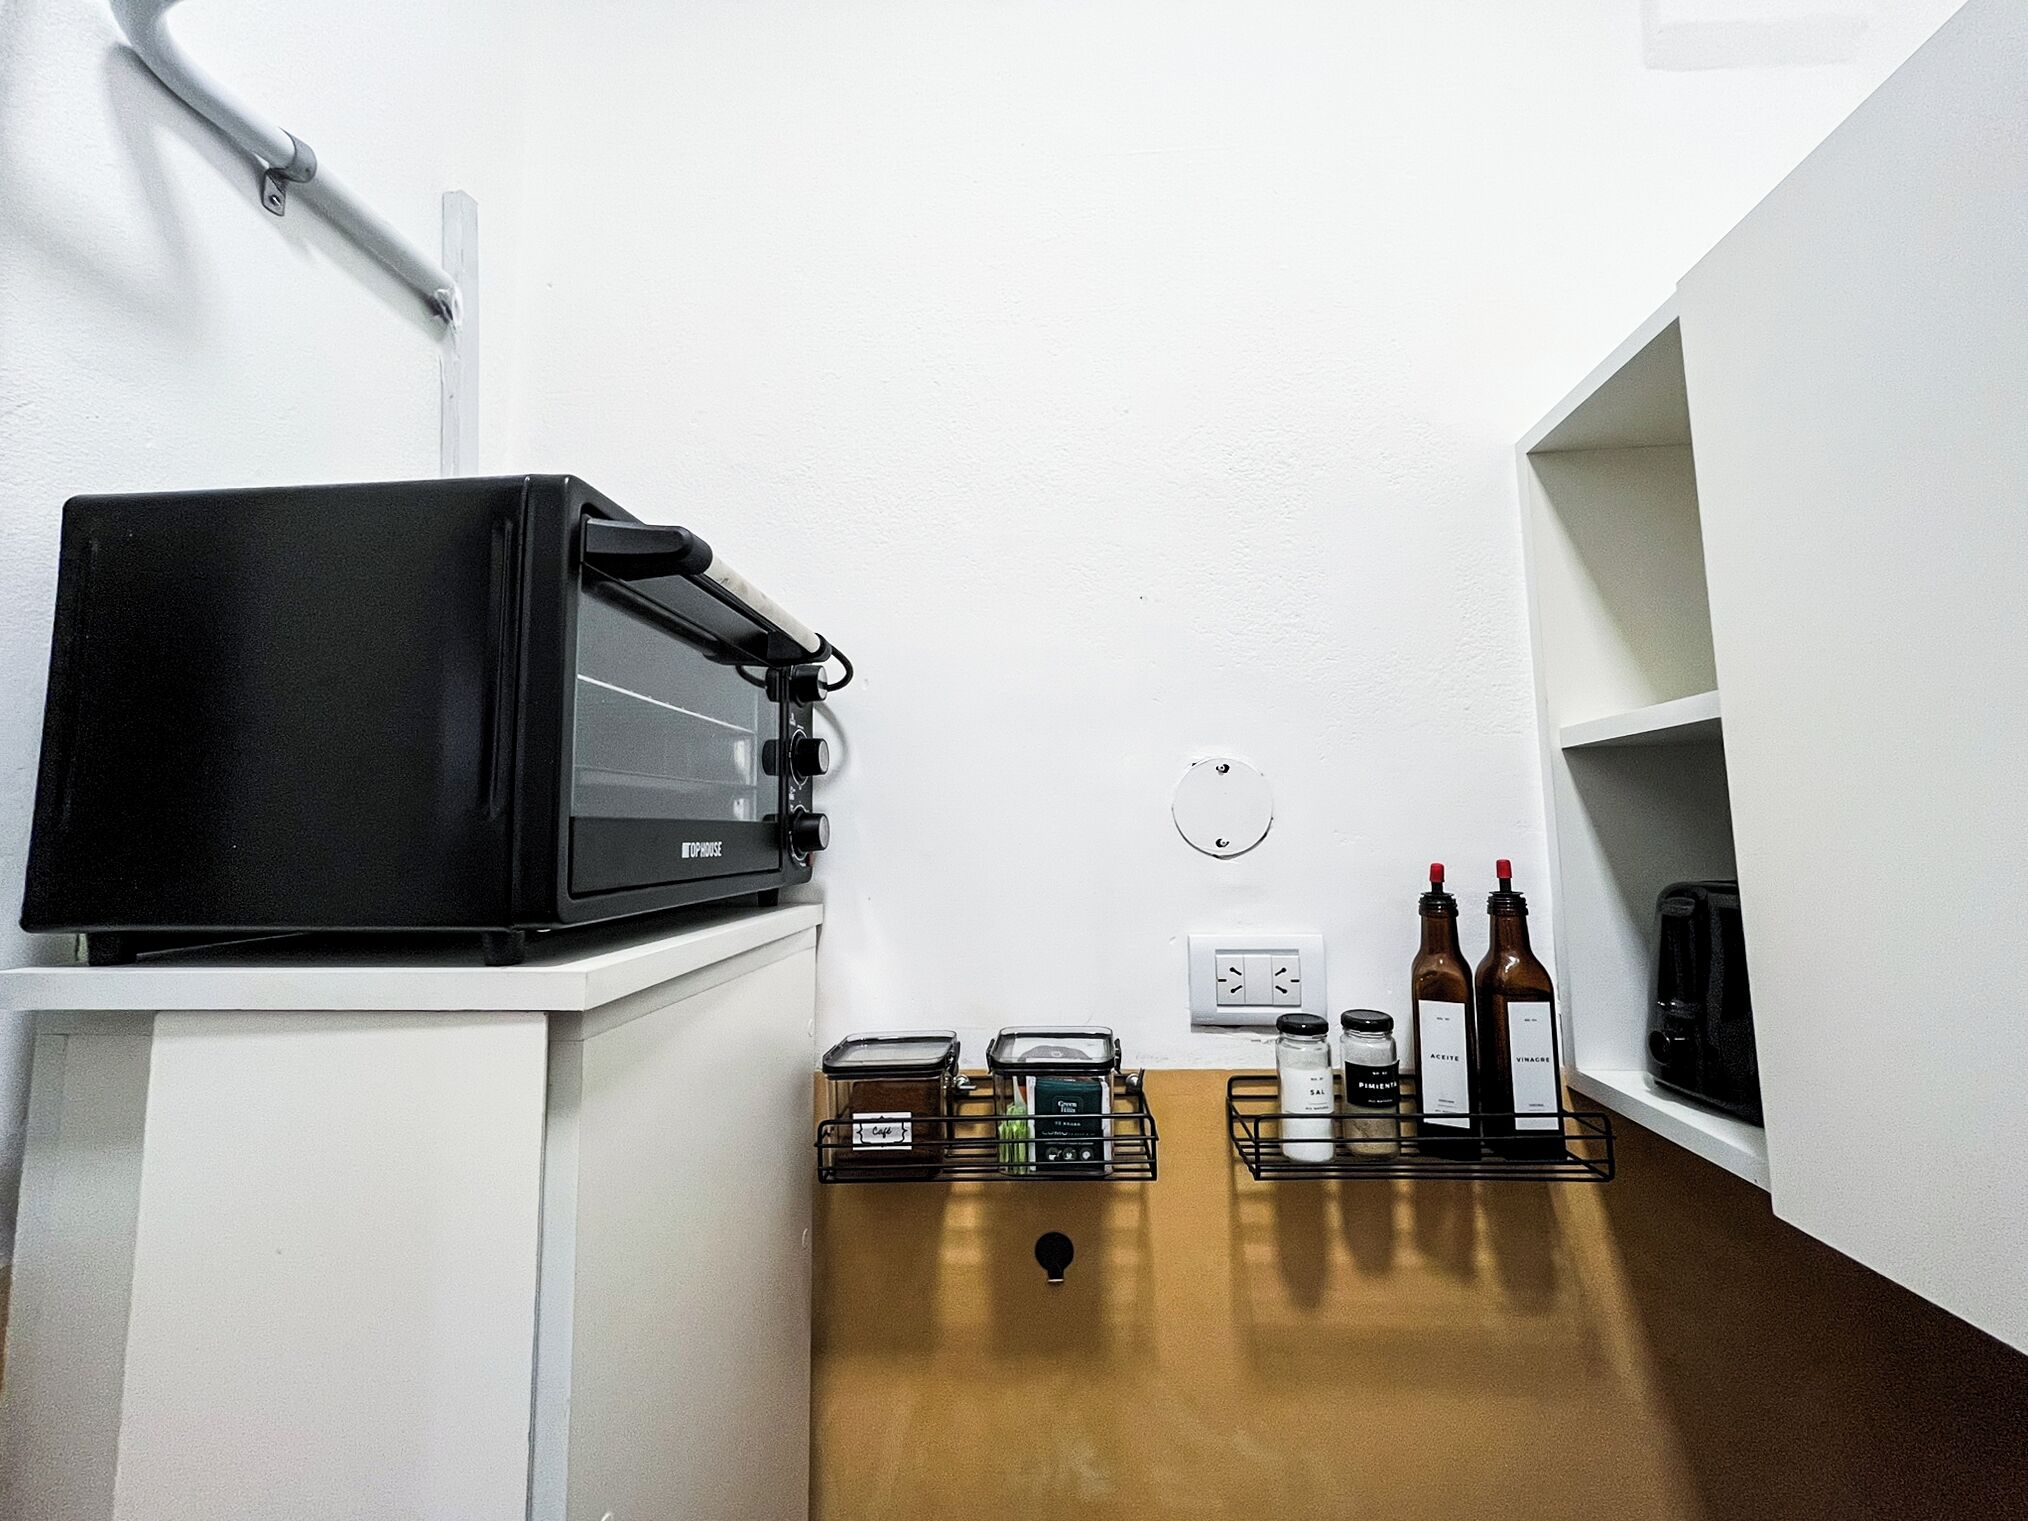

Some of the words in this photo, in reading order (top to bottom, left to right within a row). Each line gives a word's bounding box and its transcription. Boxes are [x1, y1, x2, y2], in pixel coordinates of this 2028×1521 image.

[1430, 1053, 1459, 1062] ACEITE
[1358, 1081, 1397, 1090] PIMIENTA
[1057, 1100, 1078, 1108] Green
[872, 1126, 893, 1139] Café
